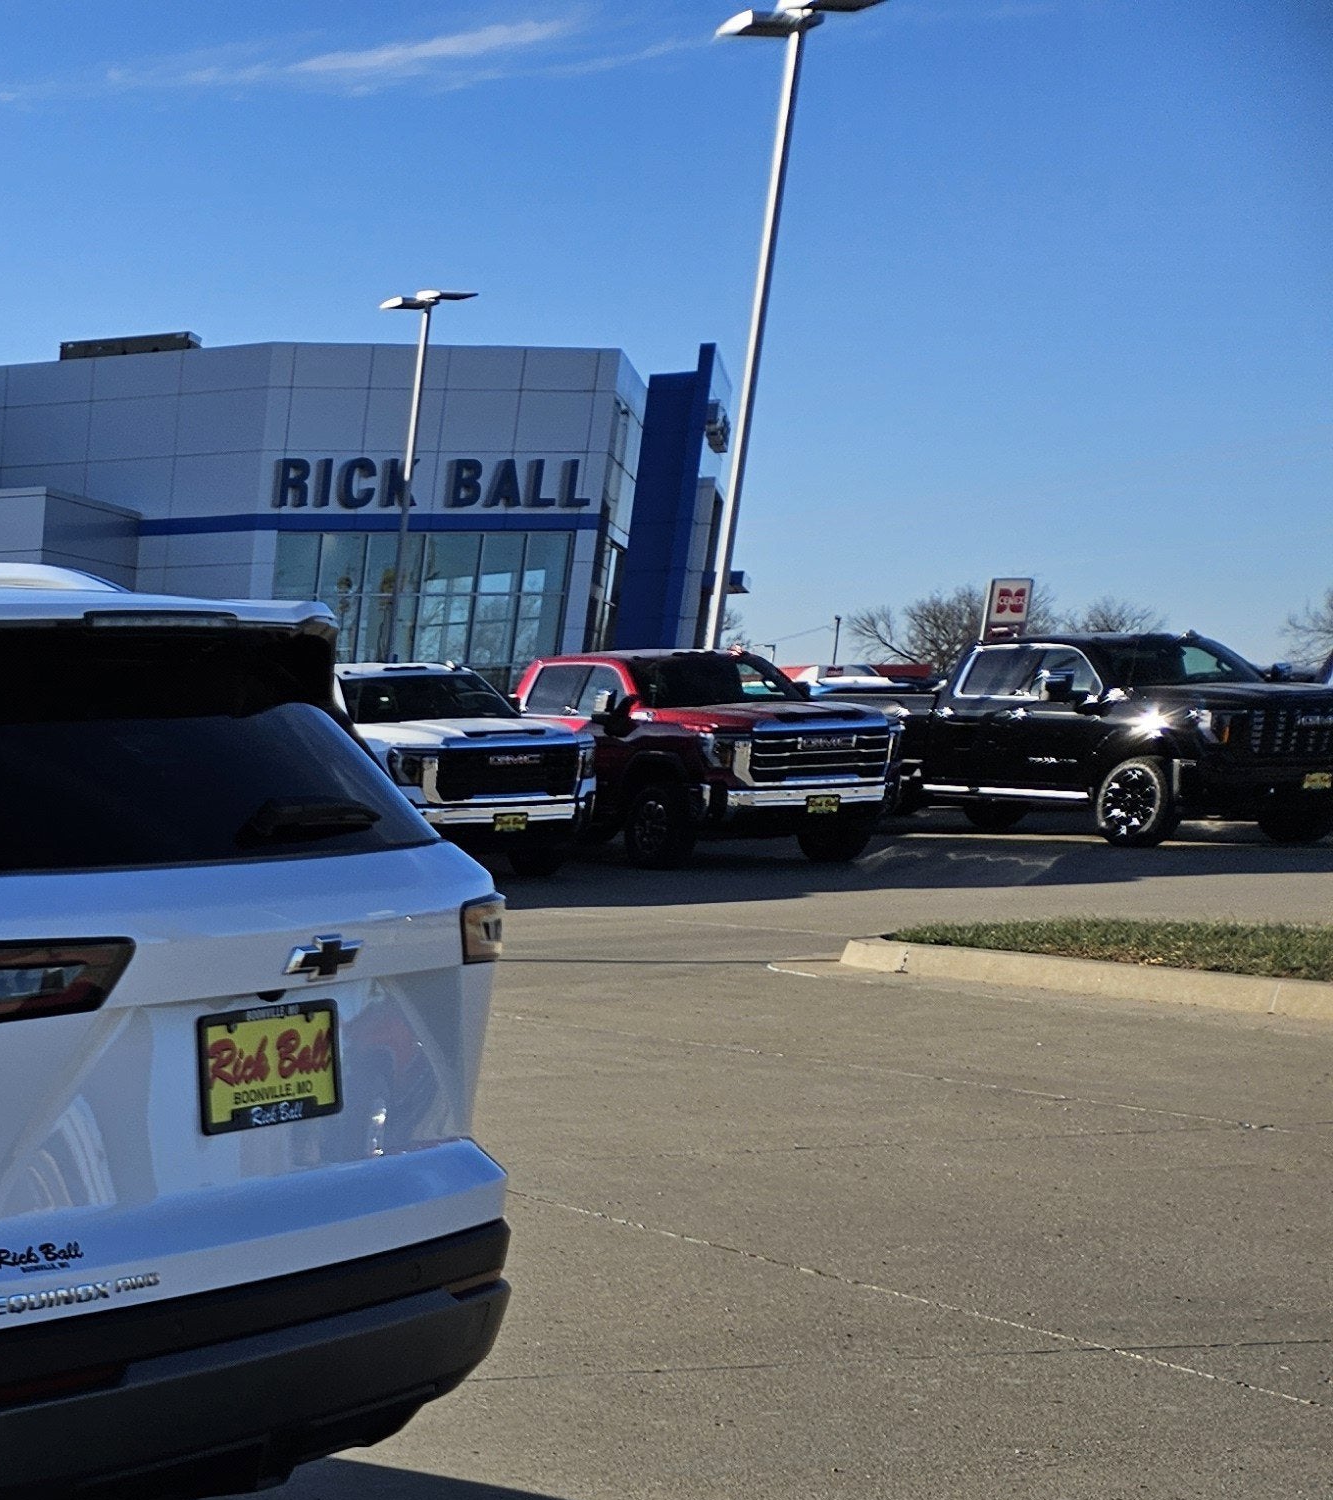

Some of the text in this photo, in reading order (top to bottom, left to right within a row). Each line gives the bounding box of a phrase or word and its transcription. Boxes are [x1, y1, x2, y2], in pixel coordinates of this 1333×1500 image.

[270, 457, 591, 509] RICK BALL
[208, 1028, 333, 1090] Rick Ball
[234, 1080, 314, 1105] BOONVILLE, MO
[250, 1101, 304, 1126] Rick Ball
[38, 1241, 84, 1262] Ball
[115, 1272, 161, 1293] AWD
